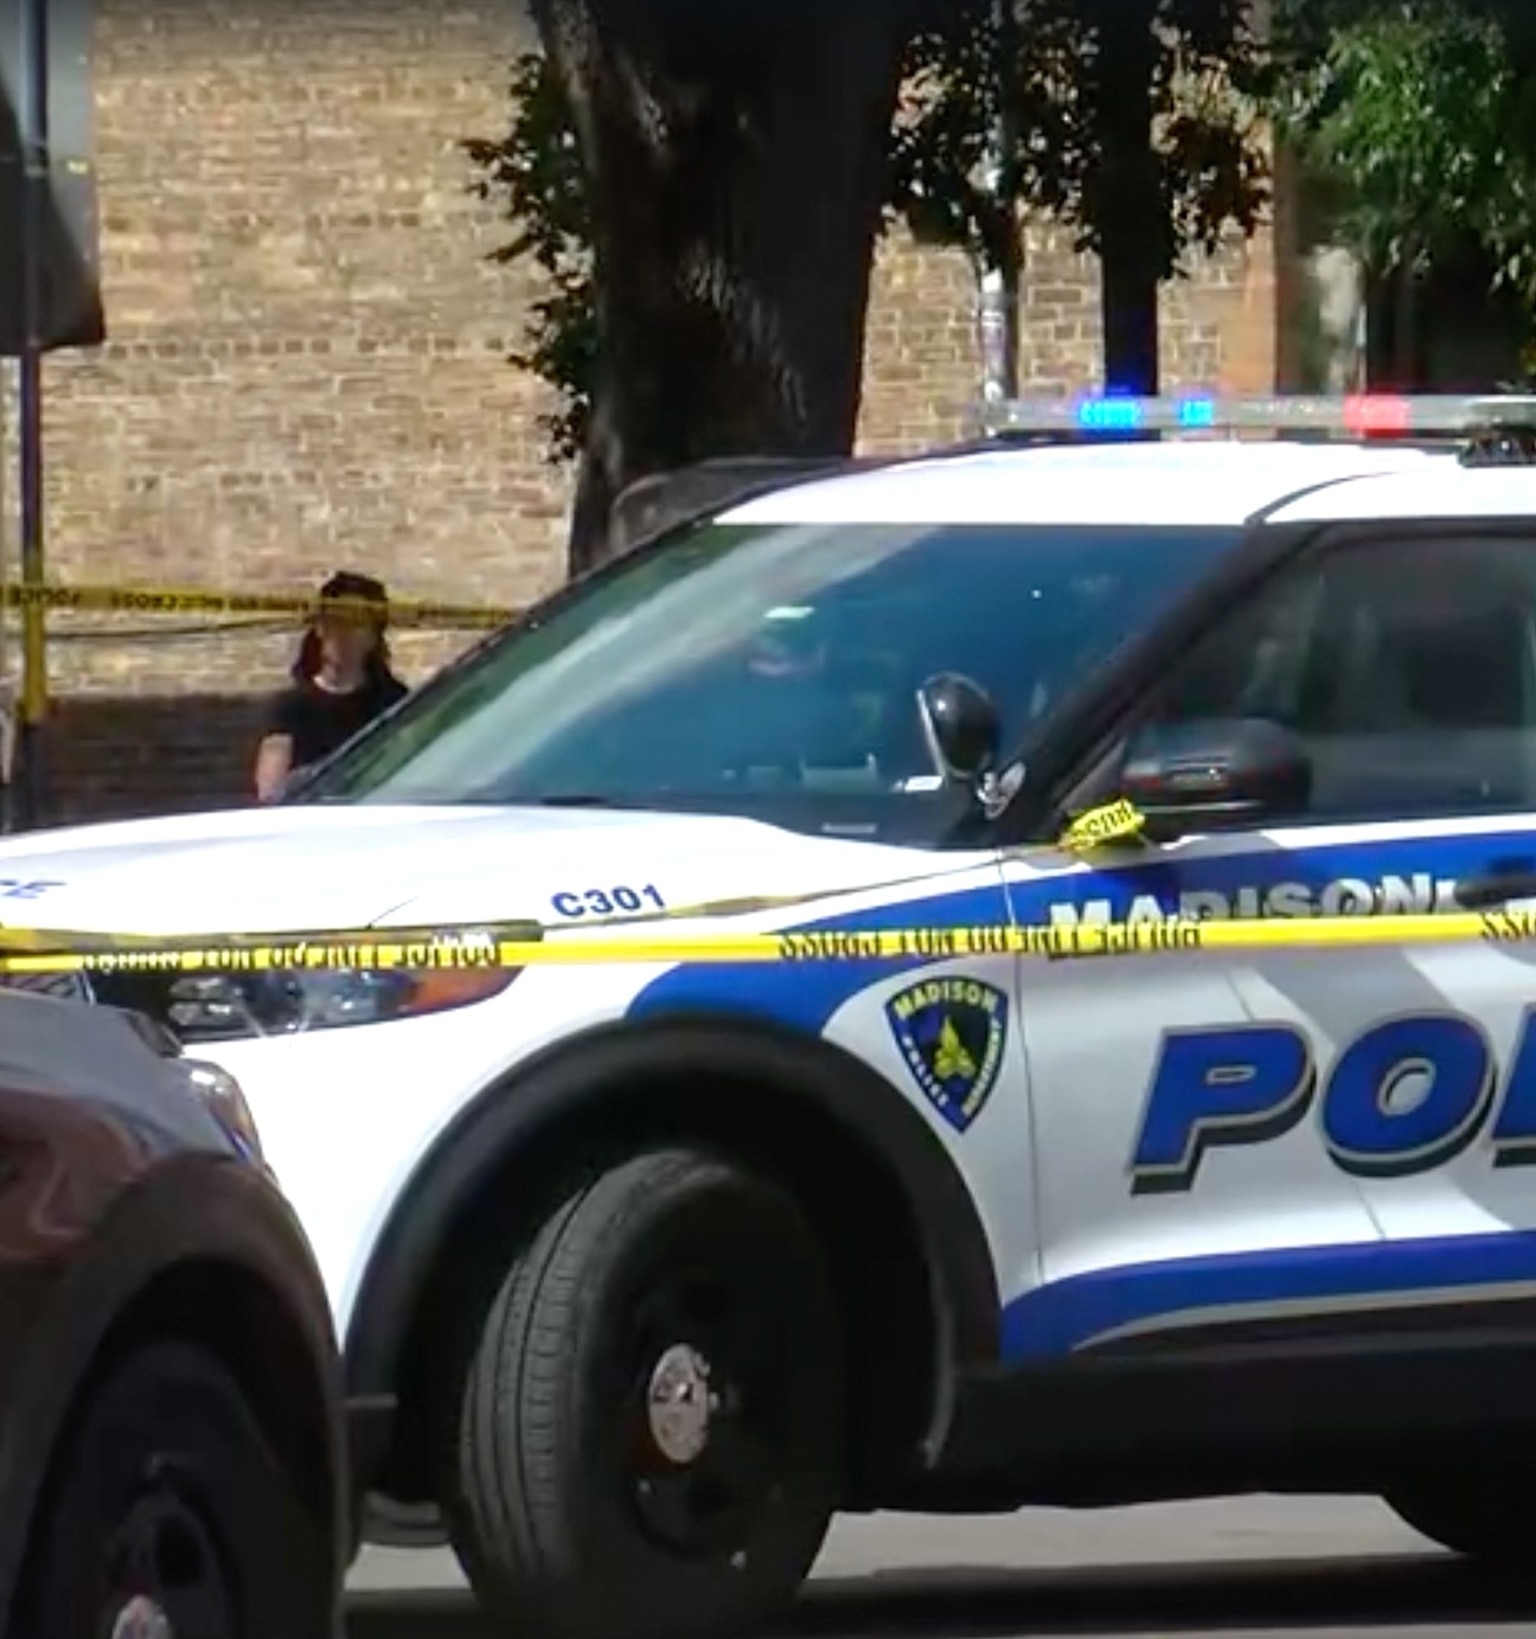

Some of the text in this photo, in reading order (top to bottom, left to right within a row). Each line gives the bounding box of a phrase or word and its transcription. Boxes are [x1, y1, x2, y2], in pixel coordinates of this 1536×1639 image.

[550, 882, 665, 918] C301
[1049, 872, 1431, 932] MADISON
[893, 976, 999, 1019] MADISON
